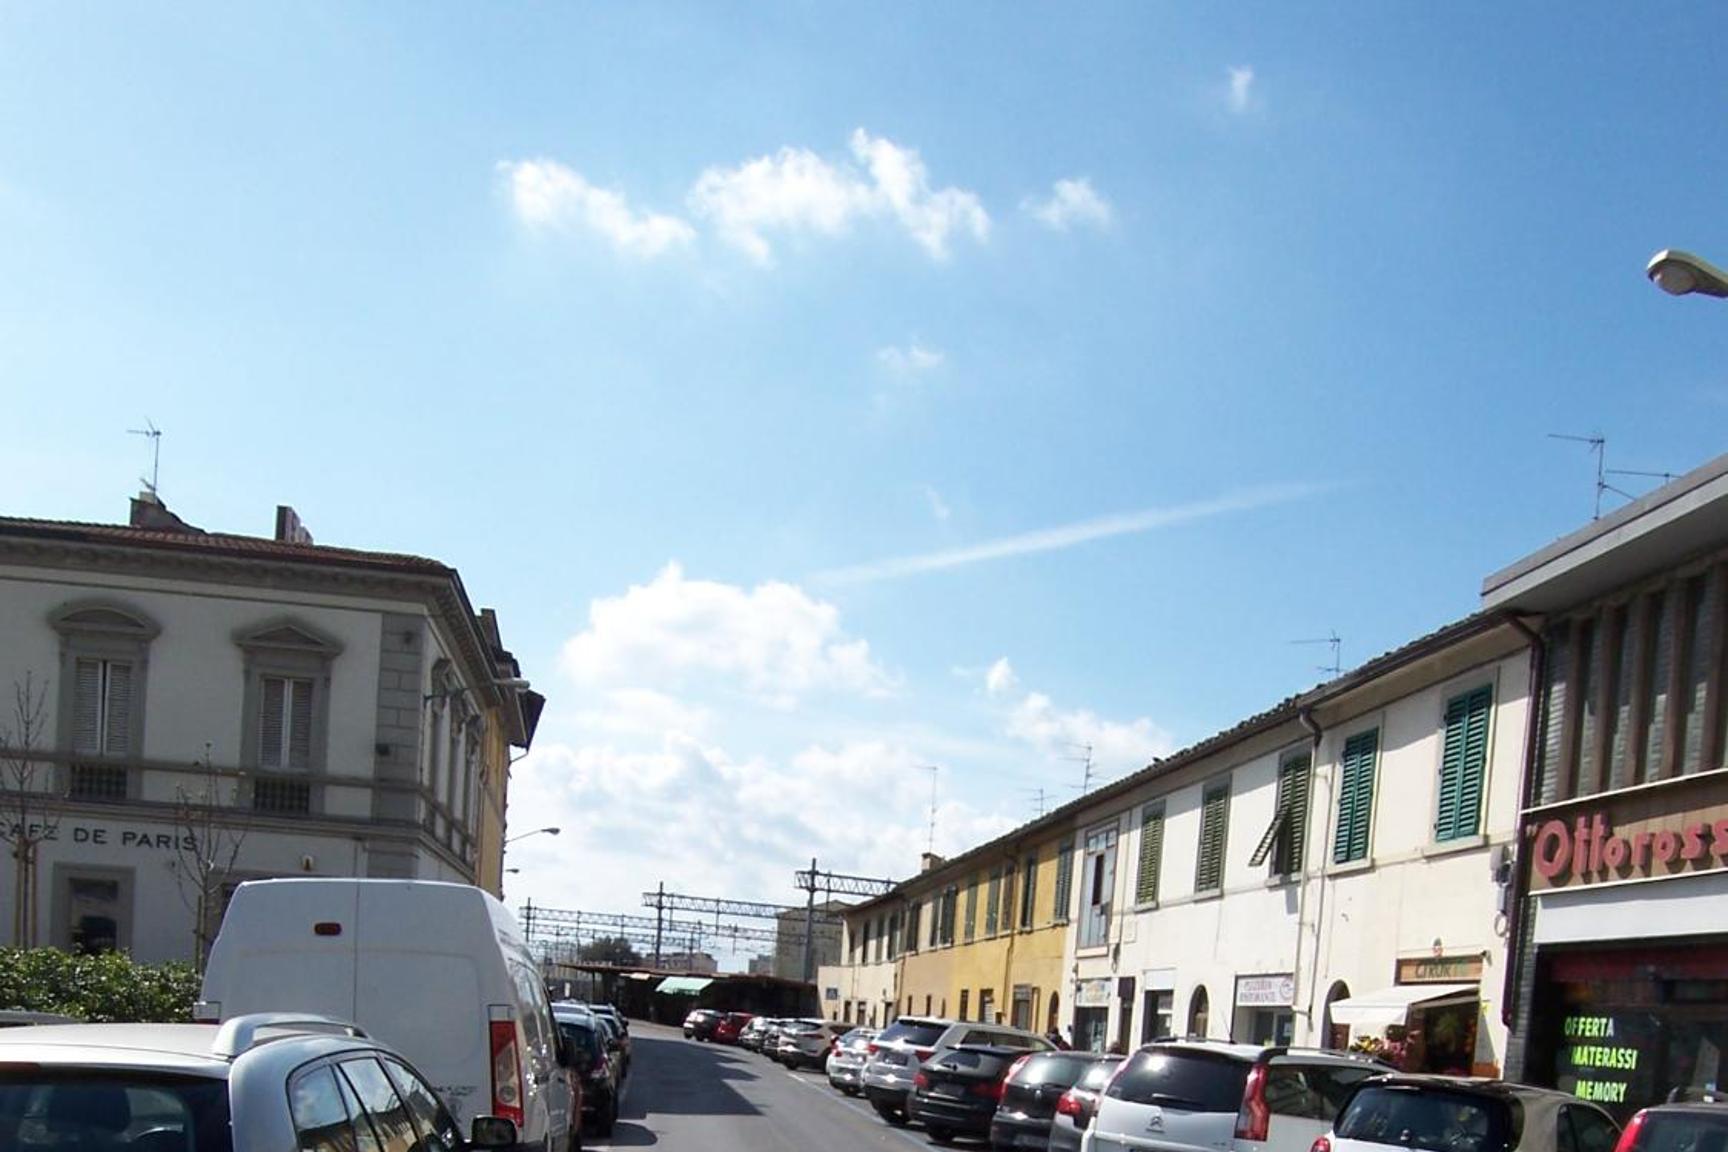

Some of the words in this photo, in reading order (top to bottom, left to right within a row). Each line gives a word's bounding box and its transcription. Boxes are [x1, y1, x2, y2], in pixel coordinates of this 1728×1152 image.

[73, 827, 108, 845] DE
[121, 831, 198, 852] PARIS
[1564, 1016, 1615, 1038] OFFERTA
[1571, 1046, 1639, 1071] MATERASSI
[1575, 1080, 1628, 1104] MEMORY
